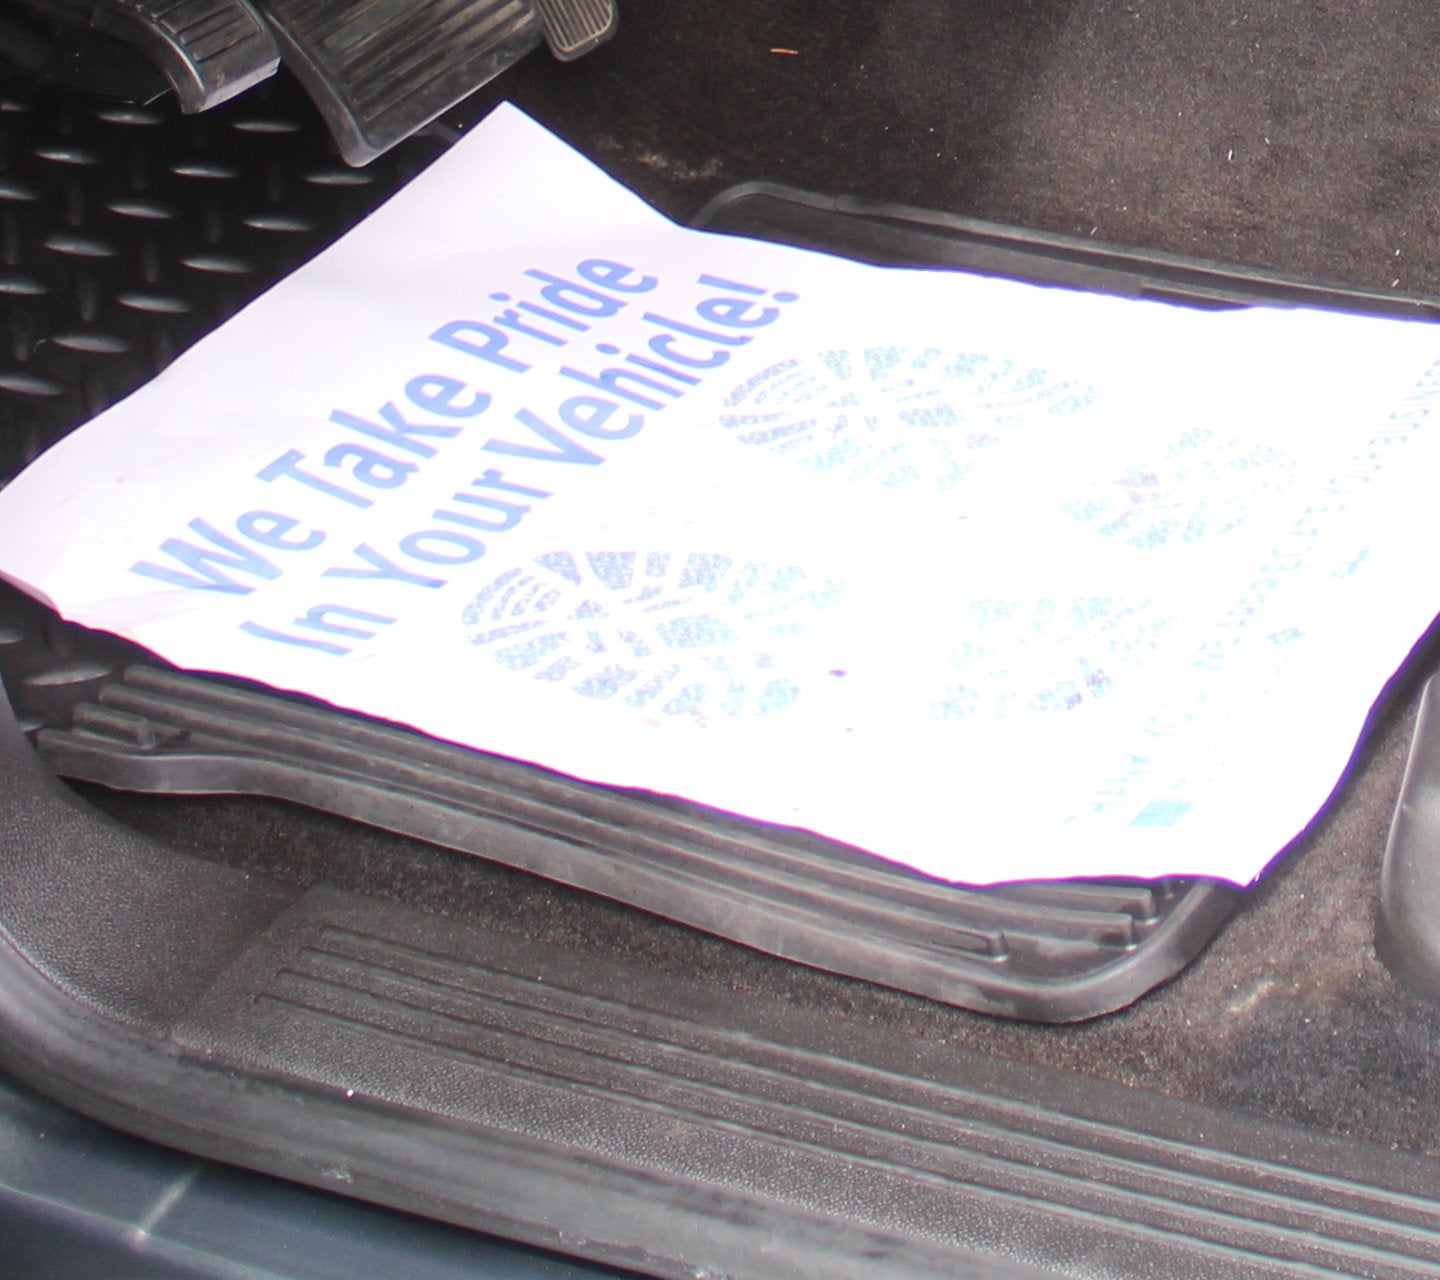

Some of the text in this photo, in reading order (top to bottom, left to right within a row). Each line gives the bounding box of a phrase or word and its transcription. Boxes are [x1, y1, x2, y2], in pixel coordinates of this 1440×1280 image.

[127, 258, 658, 596] We Take Pride
[239, 273, 800, 656] In Your Vehicle!
